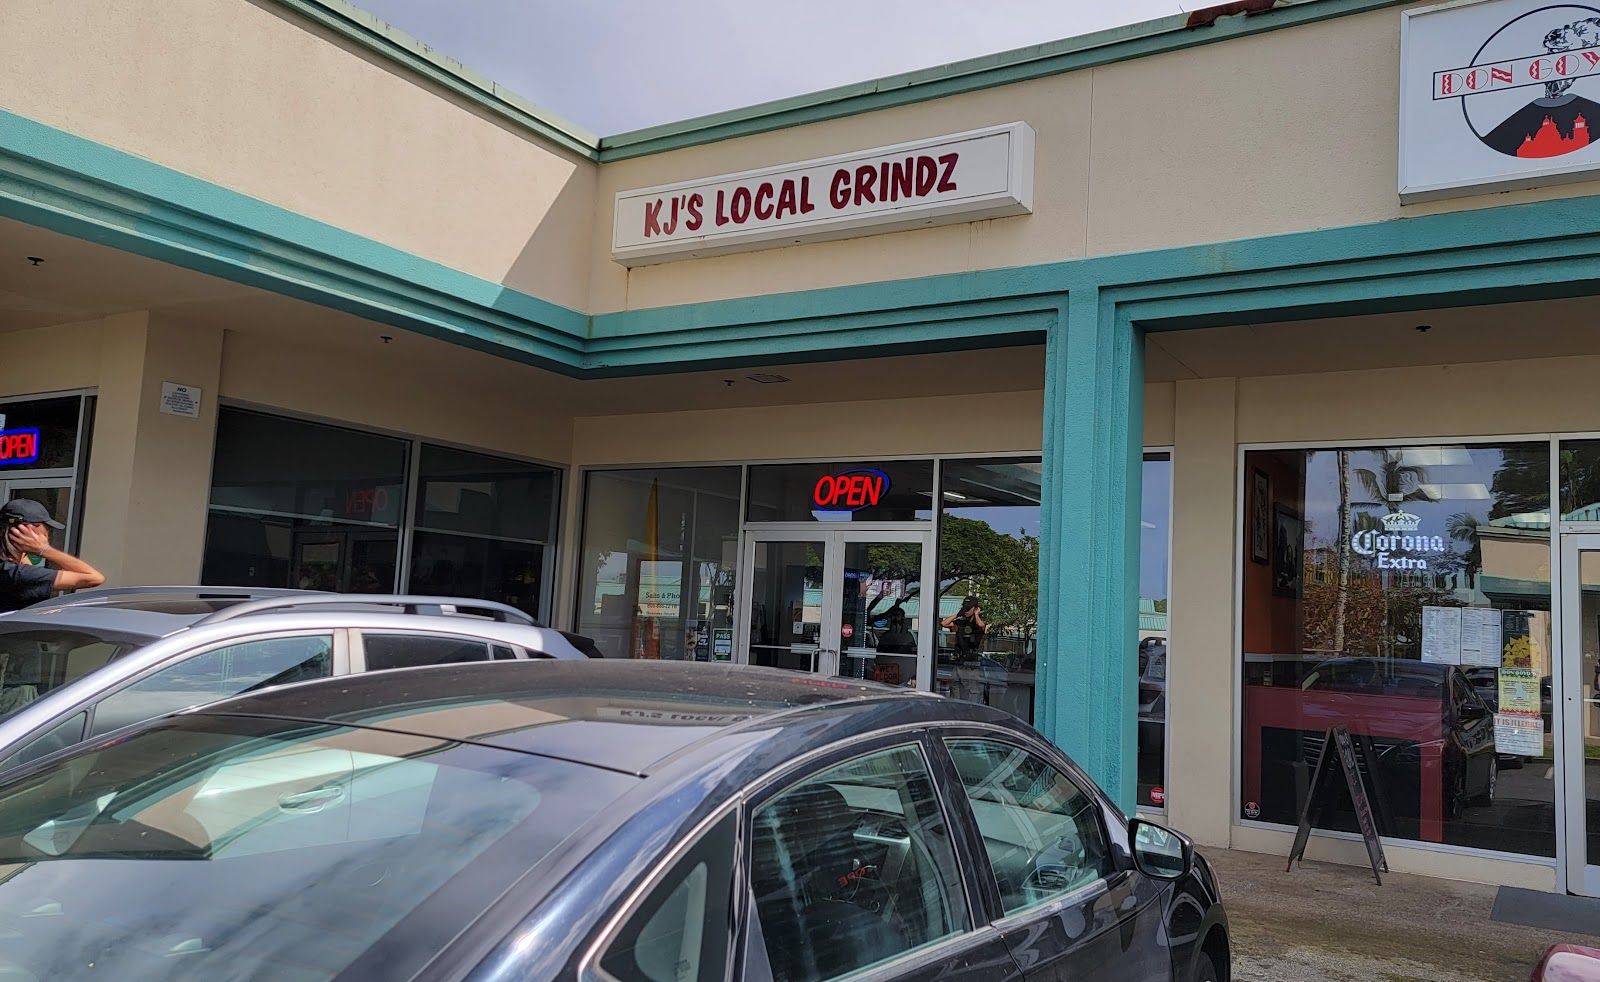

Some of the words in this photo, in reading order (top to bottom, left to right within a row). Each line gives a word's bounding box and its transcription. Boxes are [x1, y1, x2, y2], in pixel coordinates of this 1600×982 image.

[1441, 64, 1513, 95] DON
[643, 193, 704, 238] KJ'S
[715, 175, 815, 227] LOCAL
[829, 152, 960, 209] GRINDZ
[0, 433, 37, 460] OPEN
[814, 475, 882, 506] OPEN
[1352, 529, 1445, 557] Corona
[1377, 552, 1427, 569] Extra
